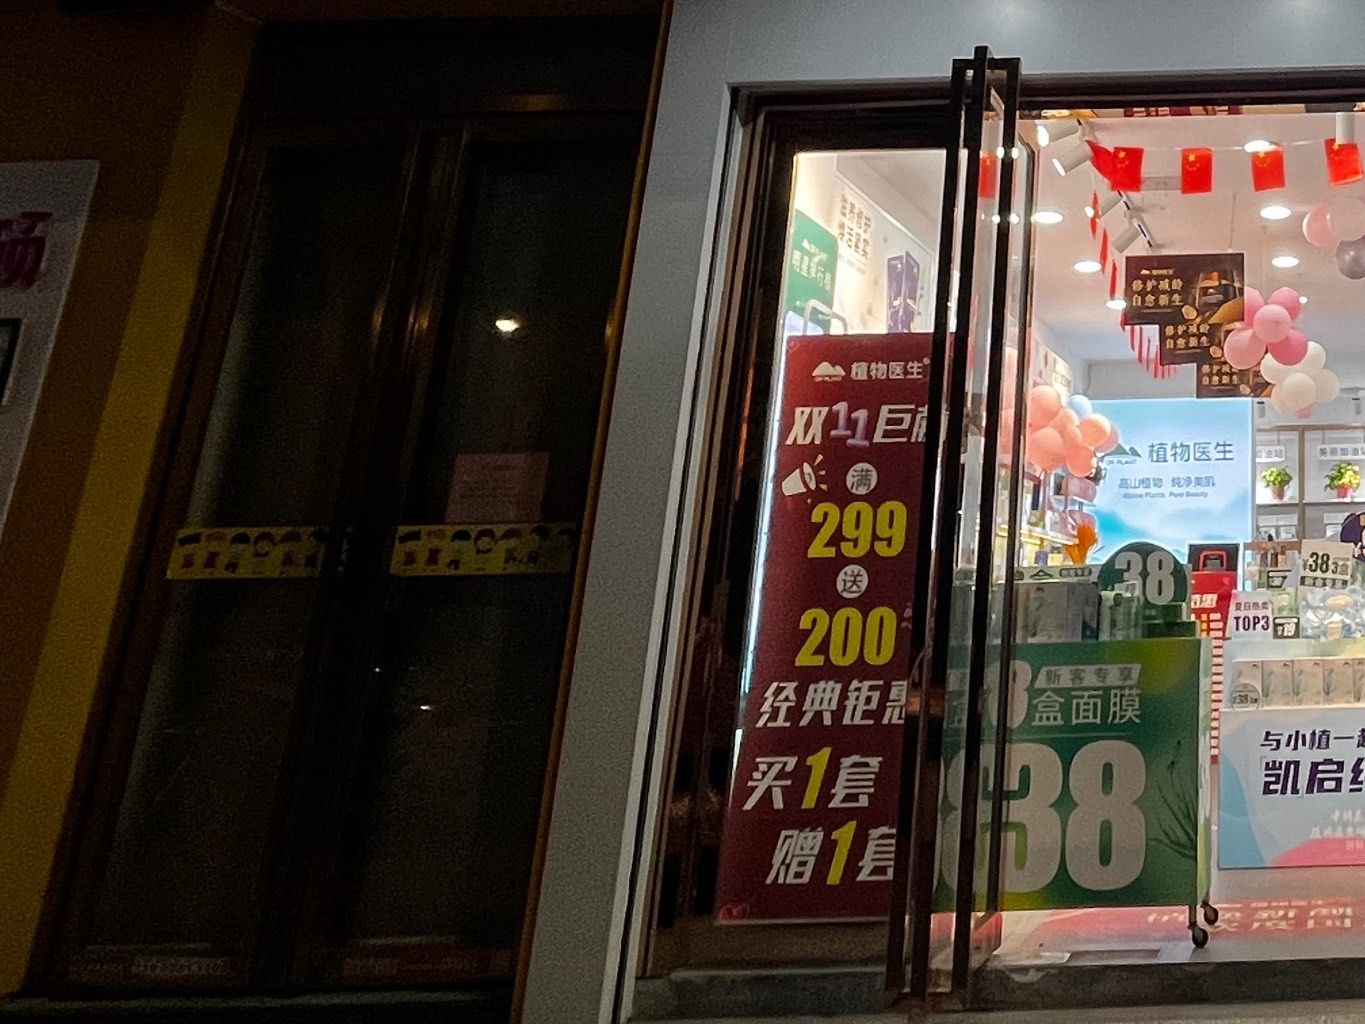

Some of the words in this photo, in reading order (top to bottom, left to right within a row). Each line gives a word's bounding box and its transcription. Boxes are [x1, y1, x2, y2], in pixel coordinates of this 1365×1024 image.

[850, 361, 923, 381] 植物医生
[1148, 440, 1234, 463] 植物医生
[849, 465, 874, 491] 满
[807, 501, 907, 558] 299
[839, 568, 864, 595] 送
[1115, 551, 1174, 606] 38
[795, 606, 897, 666] 200
[1234, 616, 1270, 631] TOP3
[743, 746, 883, 811] 买1套
[765, 820, 897, 885] 赠1套
